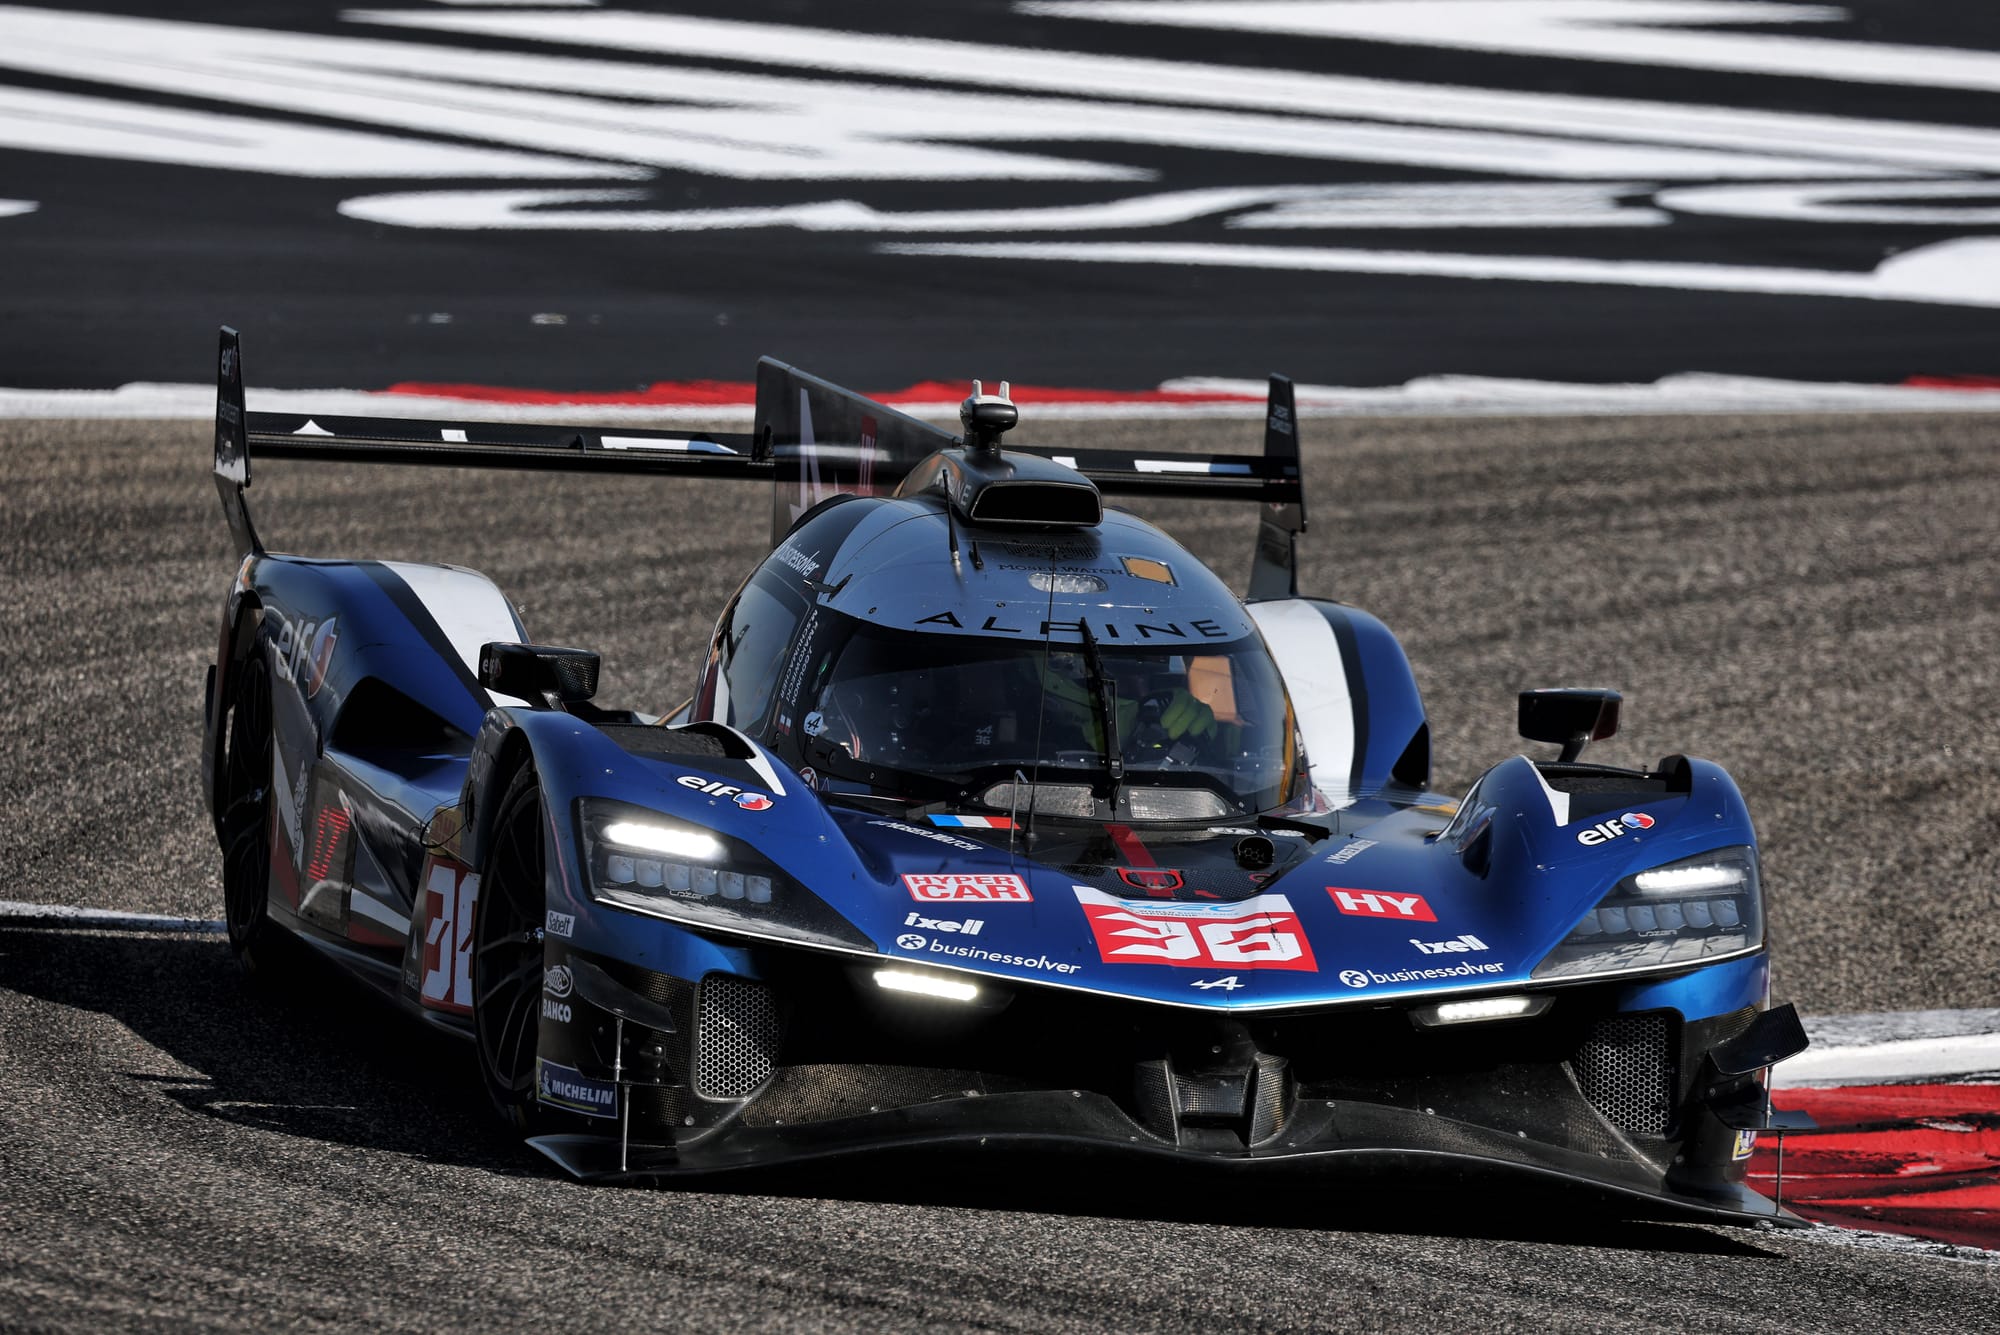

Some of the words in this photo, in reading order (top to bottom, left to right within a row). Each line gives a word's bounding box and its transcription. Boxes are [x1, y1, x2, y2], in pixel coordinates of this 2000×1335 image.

[915, 611, 1228, 638] ALPINE
[677, 776, 741, 797] elf
[1577, 819, 1625, 846] elf
[912, 875, 1014, 885] HYPER
[917, 884, 1019, 899] CAR
[1335, 891, 1419, 915] HY
[549, 913, 570, 936] Sabelt
[904, 912, 984, 935] ixell
[1095, 912, 1303, 963] 36
[1409, 935, 1489, 954] ixell
[930, 939, 1082, 975] businessolver
[1366, 961, 1505, 984] businessolver
[543, 998, 572, 1023] BAHCO
[552, 1080, 614, 1105] MICHELIN
